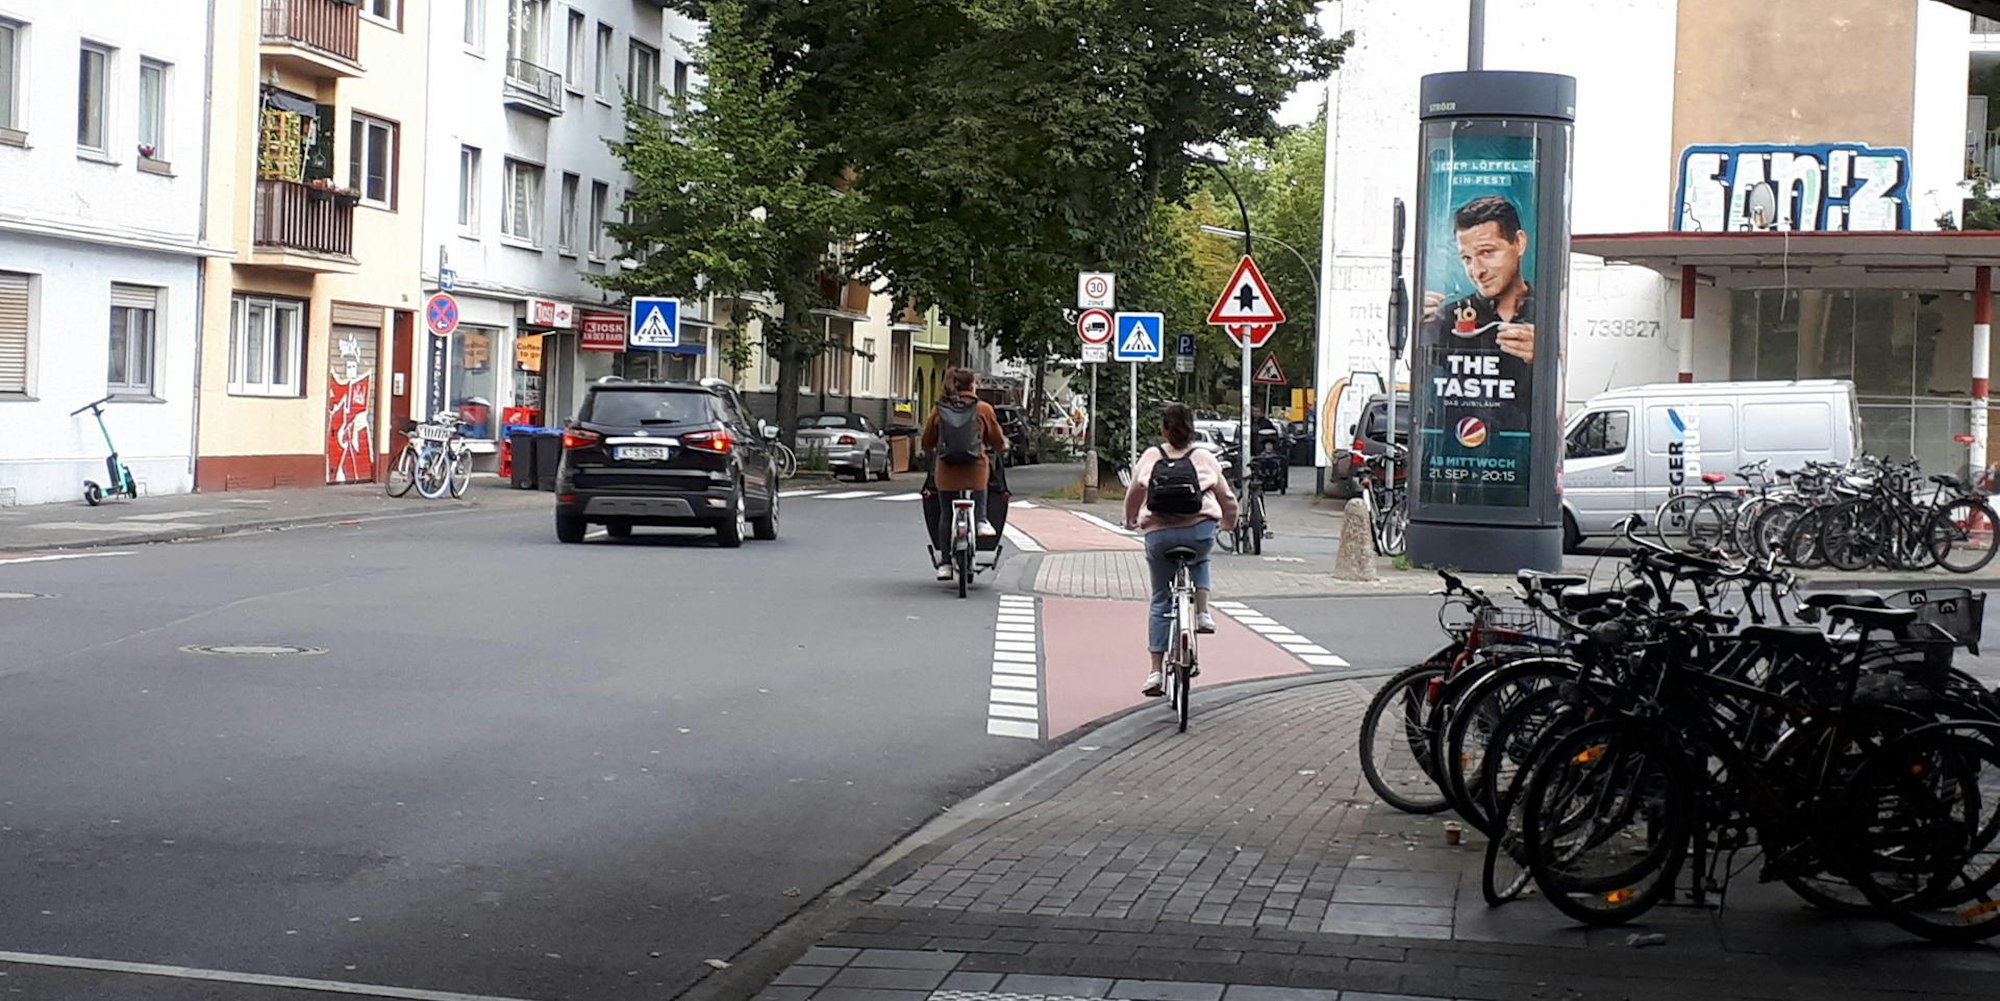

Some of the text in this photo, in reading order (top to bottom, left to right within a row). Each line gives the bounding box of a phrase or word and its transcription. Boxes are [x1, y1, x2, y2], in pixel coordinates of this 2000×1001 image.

[1429, 102, 1456, 112] STRÖER
[1435, 161, 1468, 171] JEDER
[1472, 159, 1519, 171] LÖFFEL
[1453, 174, 1506, 185] EIN FEST
[1090, 282, 1103, 293] 30
[1453, 306, 1477, 321] 10
[1587, 319, 1660, 337] 733827
[1447, 355, 1500, 375] THE
[1433, 378, 1516, 399] TASTE
[1429, 456, 1516, 468] AB MITTWOCH
[1429, 468, 1516, 481] 21. SEP 20:15
